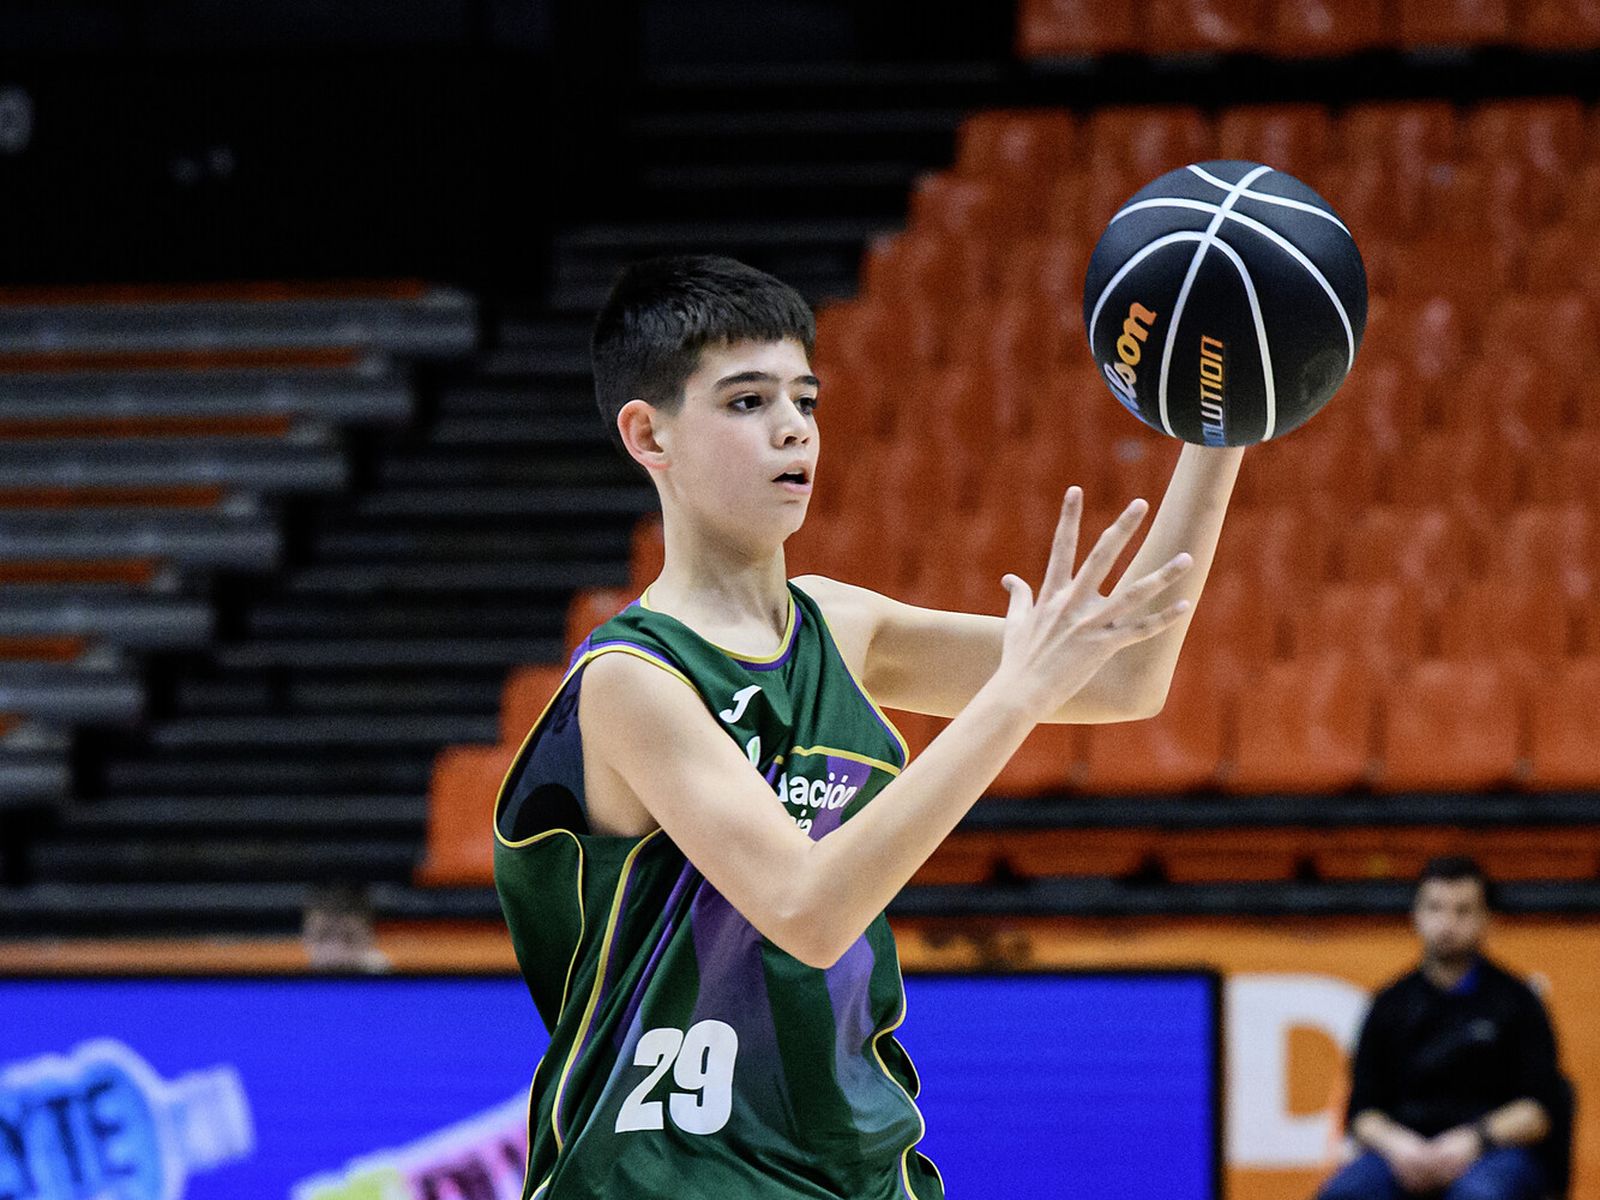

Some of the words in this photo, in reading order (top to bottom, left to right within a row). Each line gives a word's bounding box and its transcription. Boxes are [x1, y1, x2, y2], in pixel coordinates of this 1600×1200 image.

[1103, 302, 1157, 422] lson
[1200, 334, 1226, 447] OLUTION
[614, 1019, 739, 1136] 29
